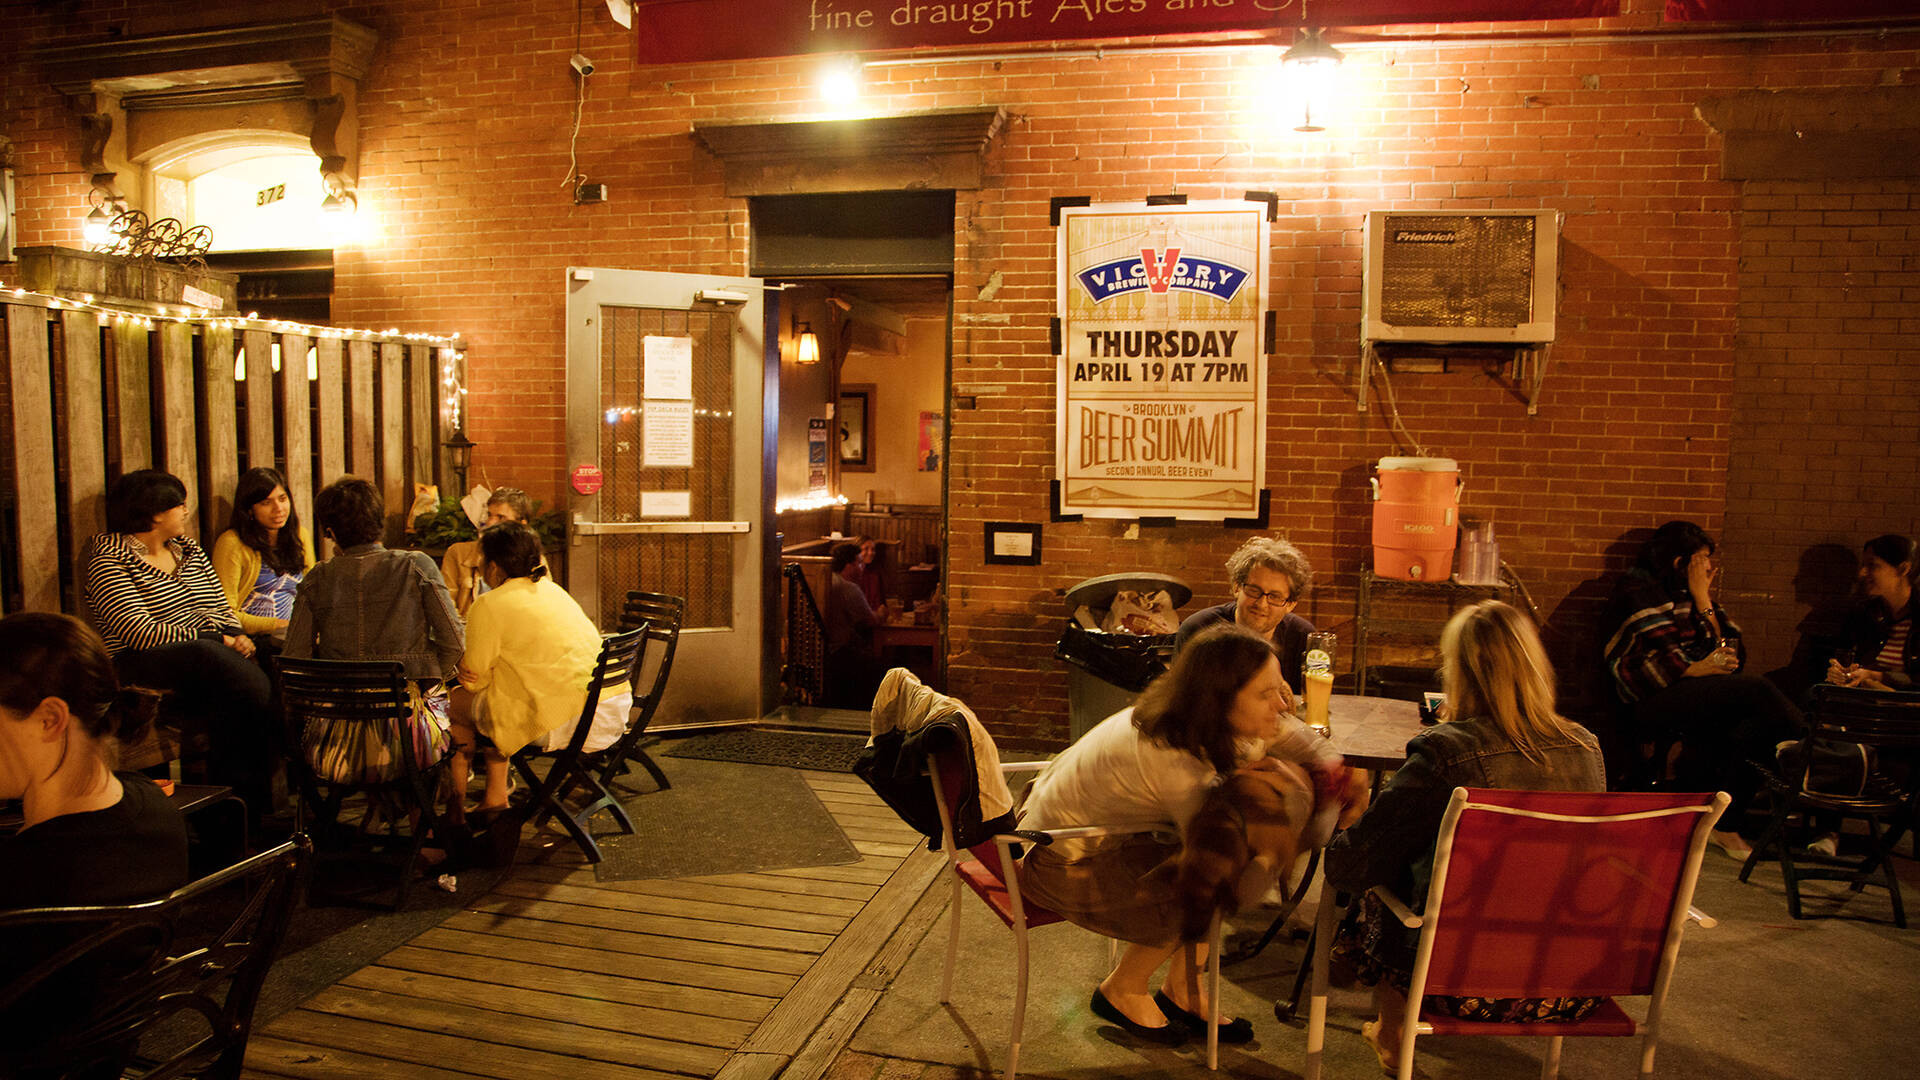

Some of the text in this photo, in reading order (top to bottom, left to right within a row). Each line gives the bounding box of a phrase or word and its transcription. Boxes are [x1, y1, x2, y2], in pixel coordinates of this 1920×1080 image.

[808, 0, 874, 31] fine
[890, 0, 1033, 34] draught
[256, 184, 286, 206] 372
[1396, 231, 1456, 241] Friedrich
[1090, 262, 1233, 287] VICTORY
[1107, 276, 1216, 291] BREWING COMPANY
[1087, 331, 1238, 358] THURSDAY
[1074, 363, 1248, 382] APRIL 19 AT 7PM
[1133, 403, 1186, 416] BROOKLYN
[1080, 406, 1243, 470] BEER SUMMIT
[1106, 466, 1213, 478] SECOND ANNUAL BEER EVENT
